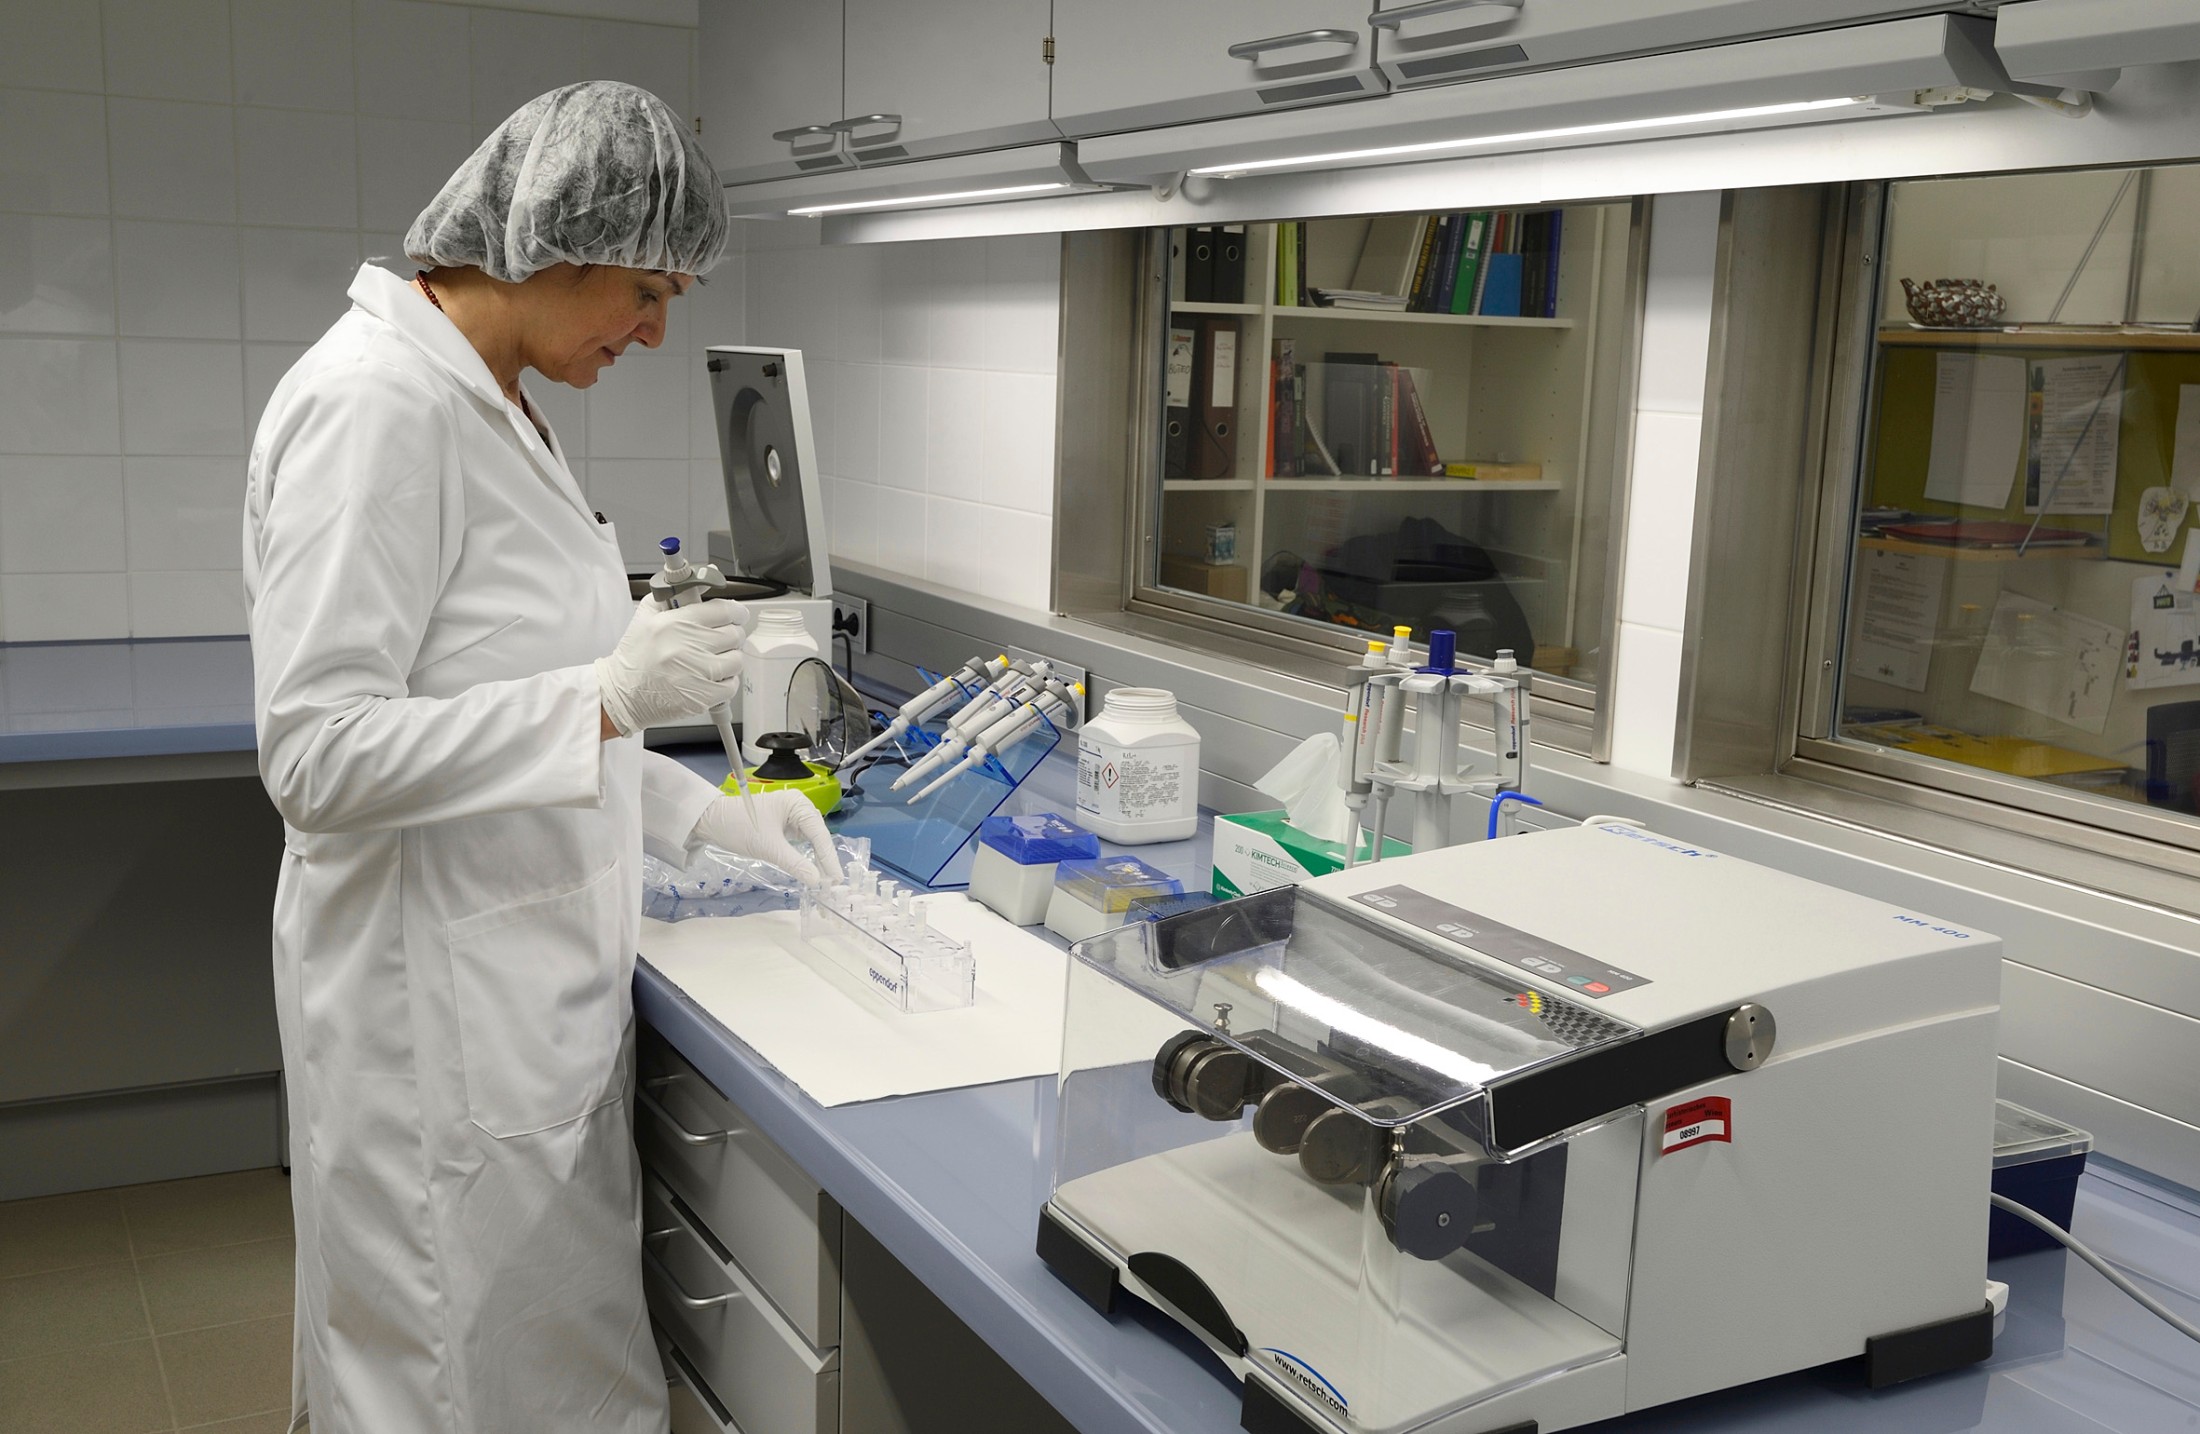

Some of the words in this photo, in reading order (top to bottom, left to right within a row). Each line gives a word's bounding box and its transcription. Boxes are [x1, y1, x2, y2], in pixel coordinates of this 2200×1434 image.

[1251, 850, 1281, 869] KIMTECH
[1893, 915, 1929, 927] MM
[1931, 926, 1970, 939] 400
[869, 967, 897, 994] eppendorf
[1274, 1353, 1349, 1418] www.retsch.com
